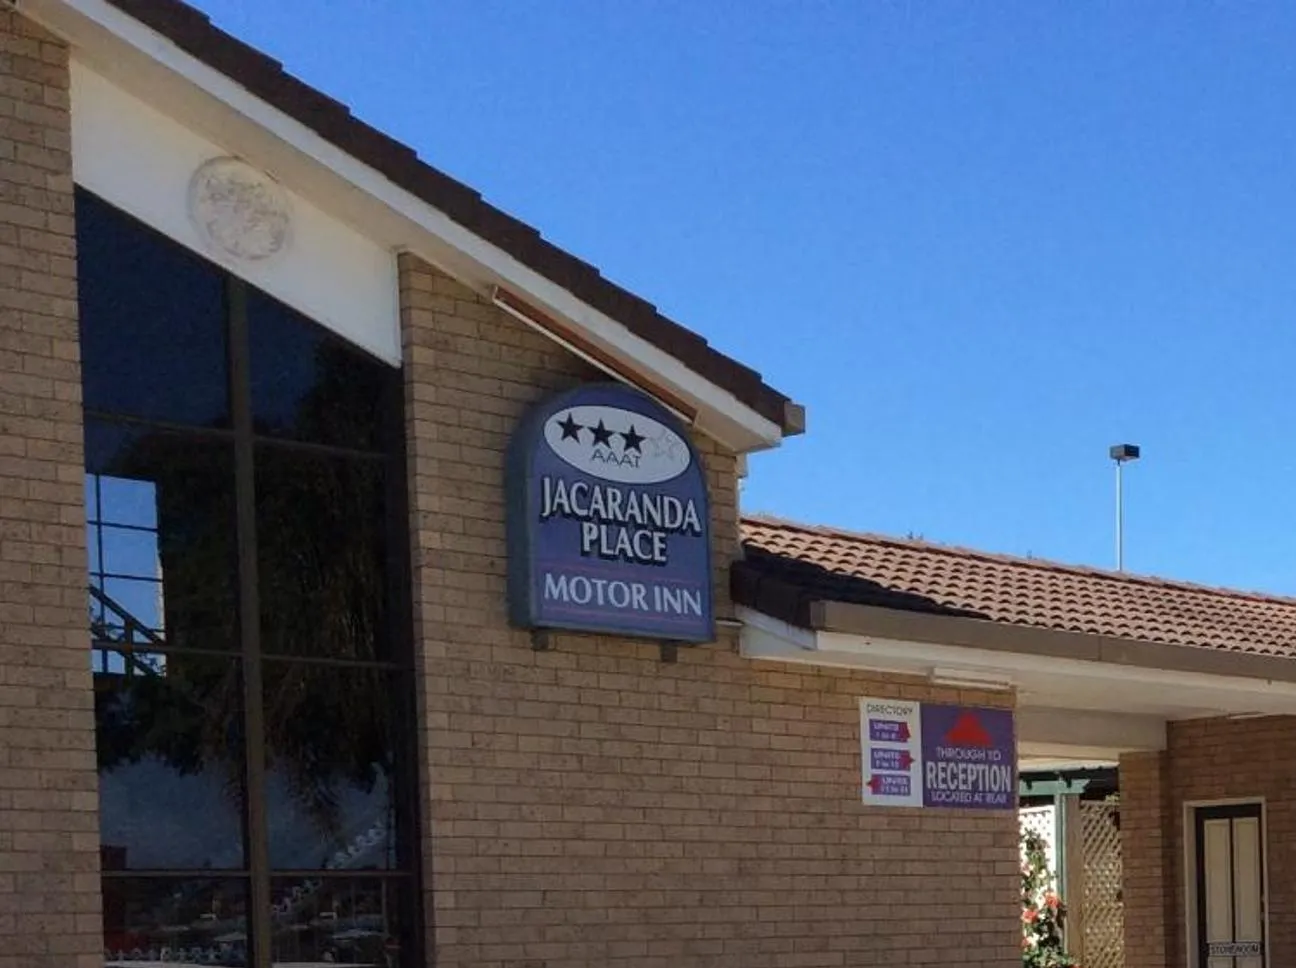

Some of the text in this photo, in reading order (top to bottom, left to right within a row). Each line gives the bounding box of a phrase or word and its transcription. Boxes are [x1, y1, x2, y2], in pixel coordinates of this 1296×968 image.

[541, 477, 702, 534] JACARANDA
[581, 522, 668, 563] PLACE
[544, 573, 702, 615] MOTOR INN
[936, 746, 1001, 761] THROUGH TO
[926, 760, 1011, 793] RECEPTION
[931, 790, 971, 803] LOCATED
